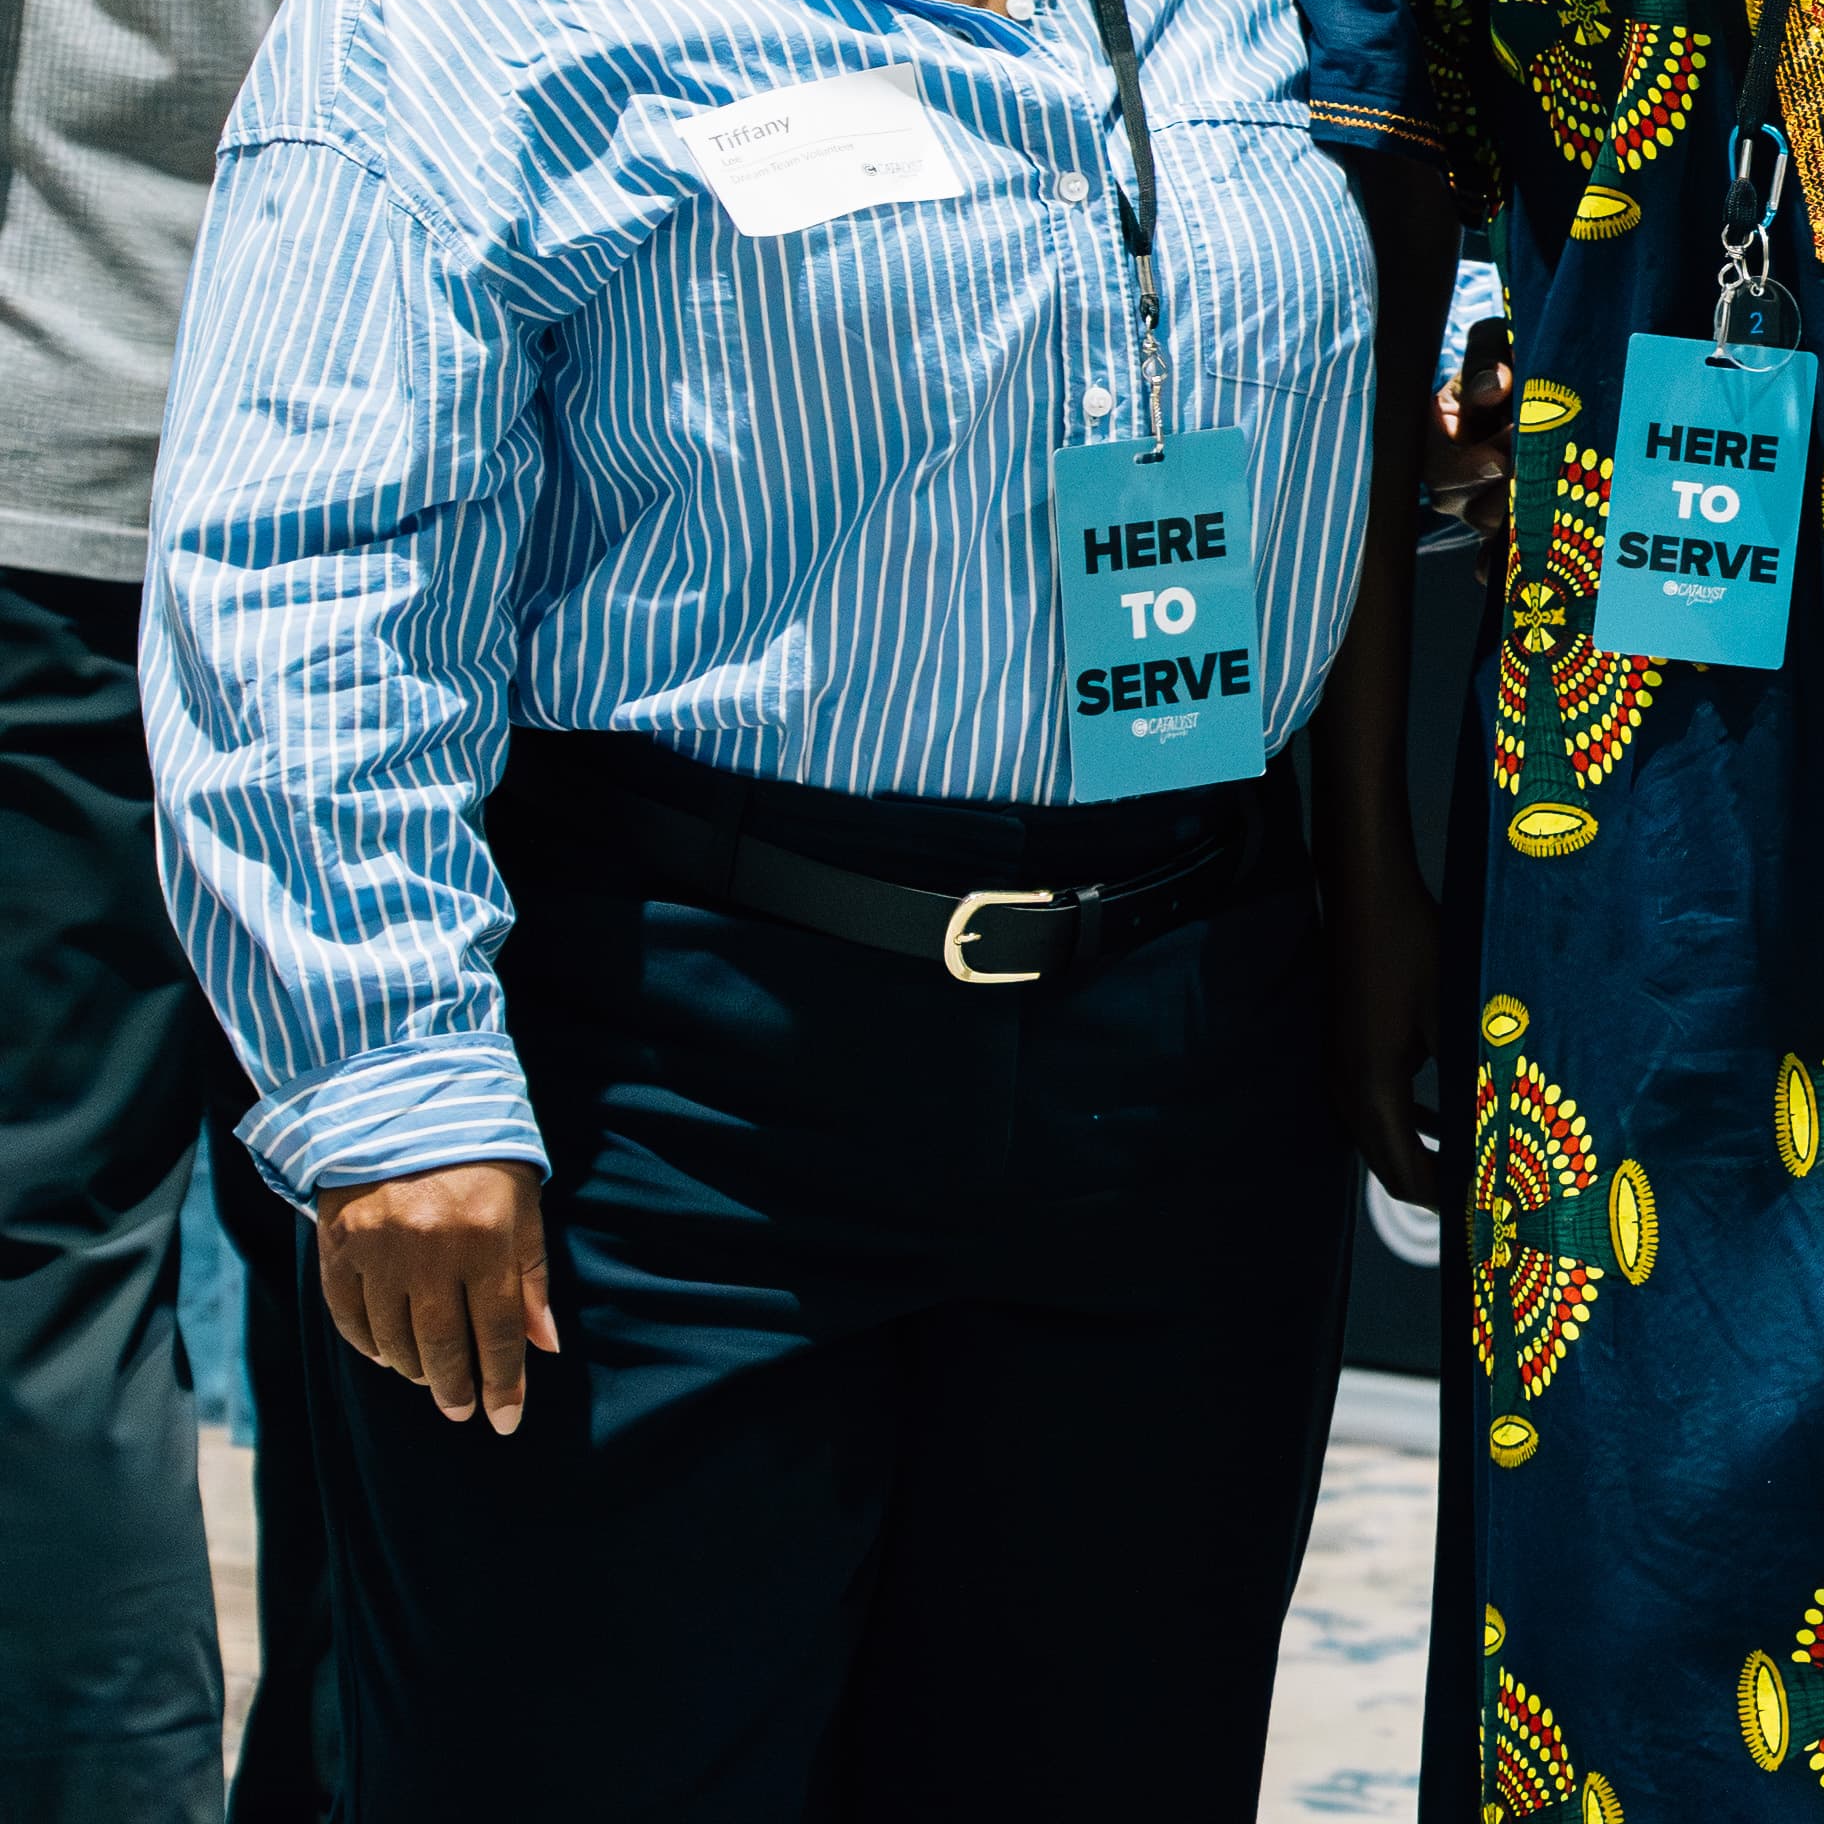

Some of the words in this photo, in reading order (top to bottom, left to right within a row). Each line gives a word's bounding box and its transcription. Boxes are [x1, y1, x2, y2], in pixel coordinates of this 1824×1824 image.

[709, 116, 791, 153] Tiffany
[1645, 422, 1779, 473] HERE
[1671, 480, 1740, 524] TO
[1083, 511, 1227, 575] HERE
[1616, 531, 1780, 585] SERVE
[1120, 586, 1196, 639] TO
[1076, 648, 1251, 717] SERVE
